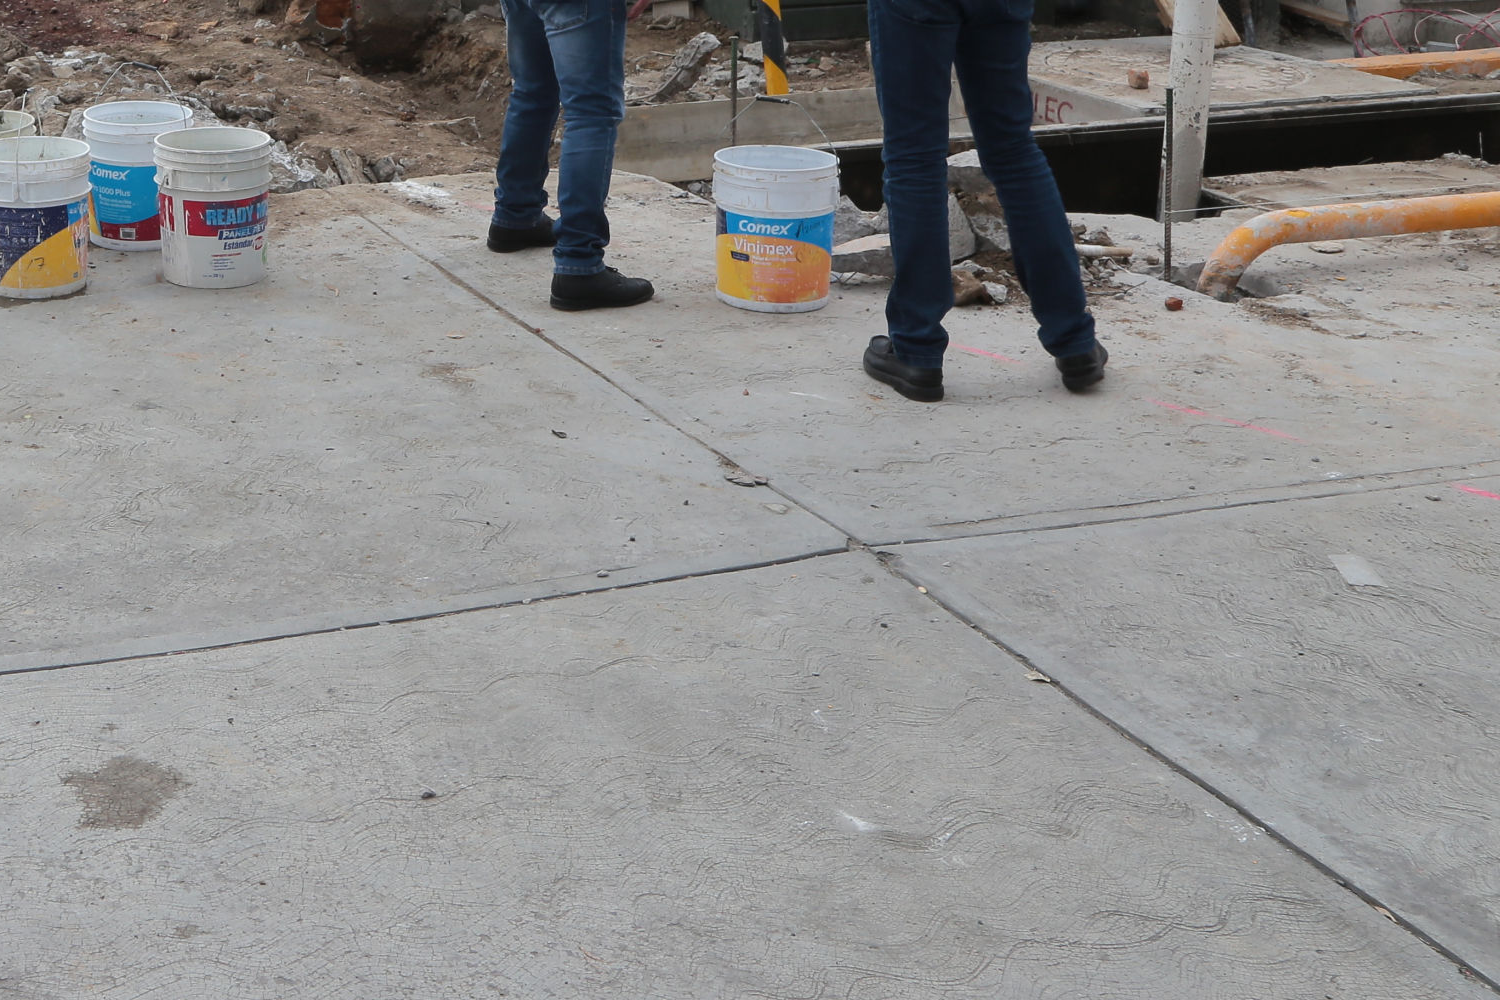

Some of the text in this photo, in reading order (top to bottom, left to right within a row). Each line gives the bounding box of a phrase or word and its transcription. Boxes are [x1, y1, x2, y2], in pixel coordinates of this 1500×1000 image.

[99, 185, 114, 195] 1000
[115, 187, 132, 197] Plus
[206, 204, 254, 226] READY
[222, 227, 252, 238] PANEL
[739, 220, 794, 236] Comex
[733, 236, 794, 256] Vinimex
